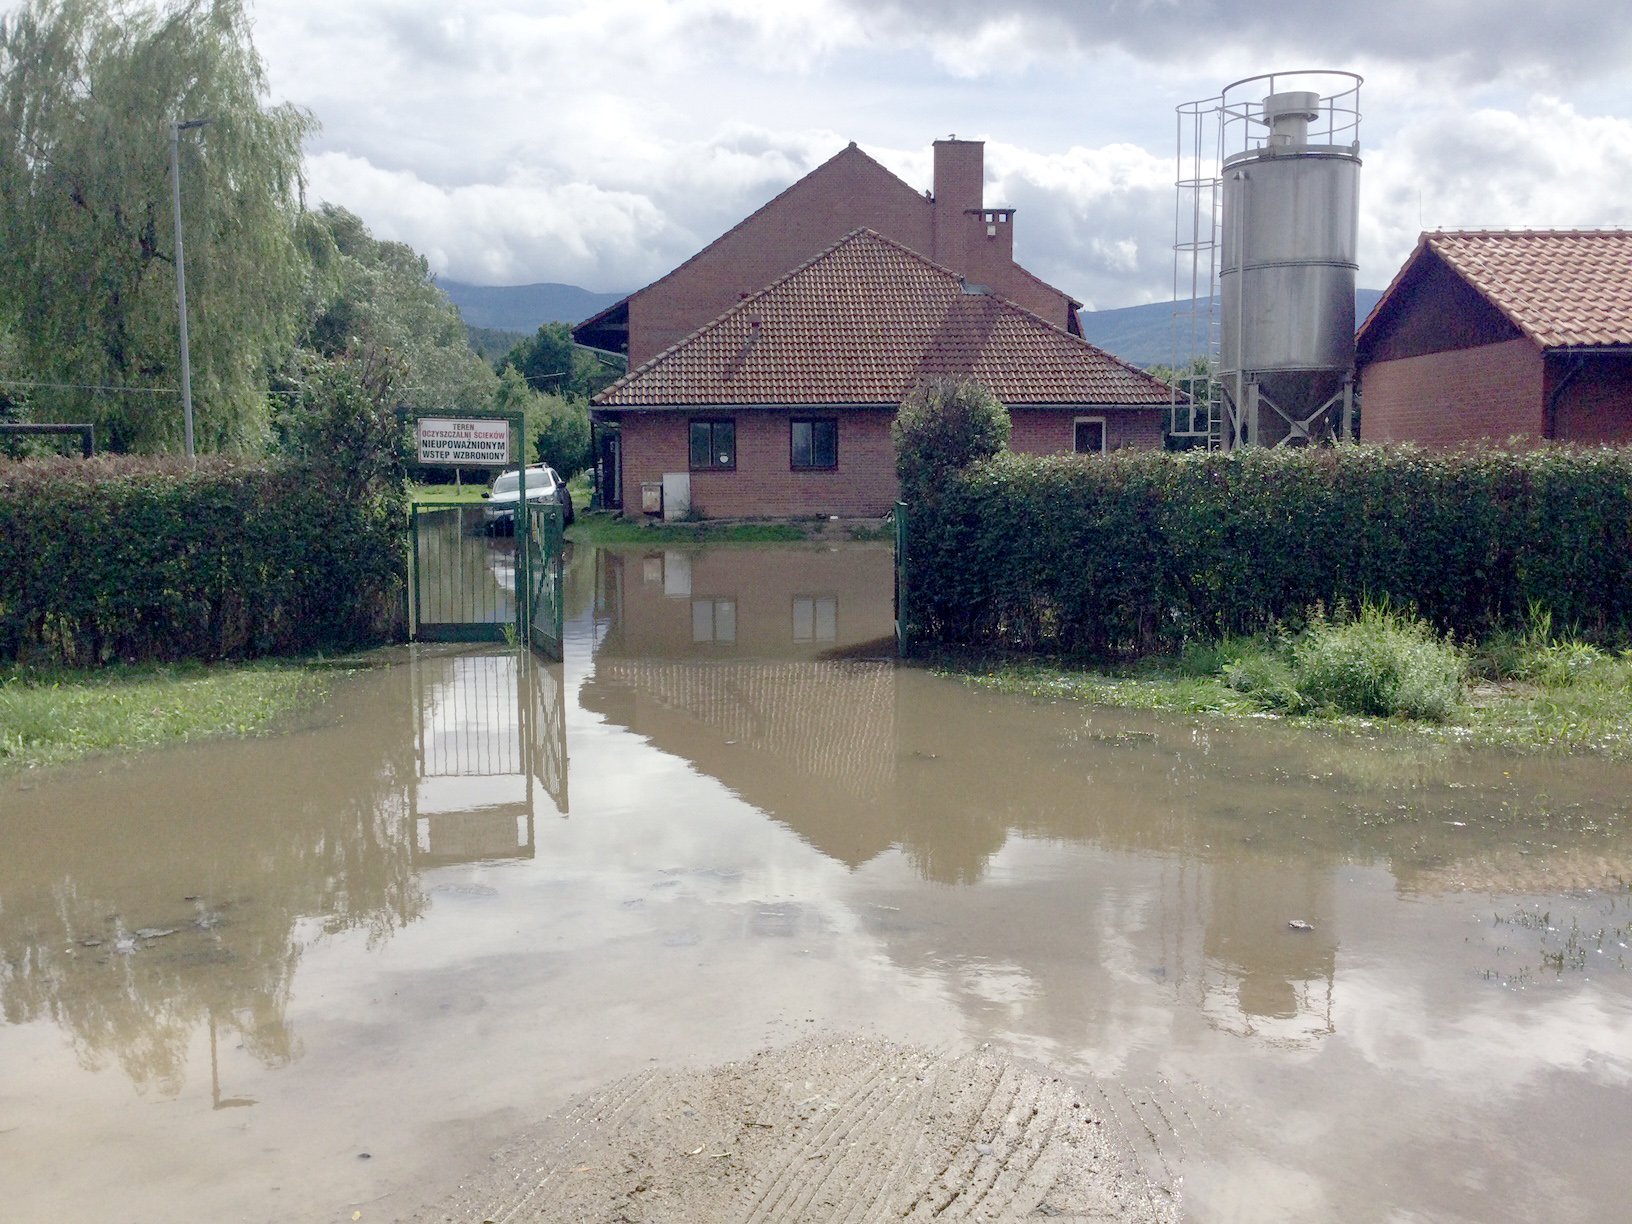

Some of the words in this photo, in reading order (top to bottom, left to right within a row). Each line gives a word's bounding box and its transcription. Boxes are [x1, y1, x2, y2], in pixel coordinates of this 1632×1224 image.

[422, 430, 472, 438] OCZYSZCZALNI
[474, 430, 504, 439] ŚCIEKÓW
[422, 439, 505, 450] NIEUPOWAŻNIONYM
[452, 452, 505, 460] WZBRONIONY
